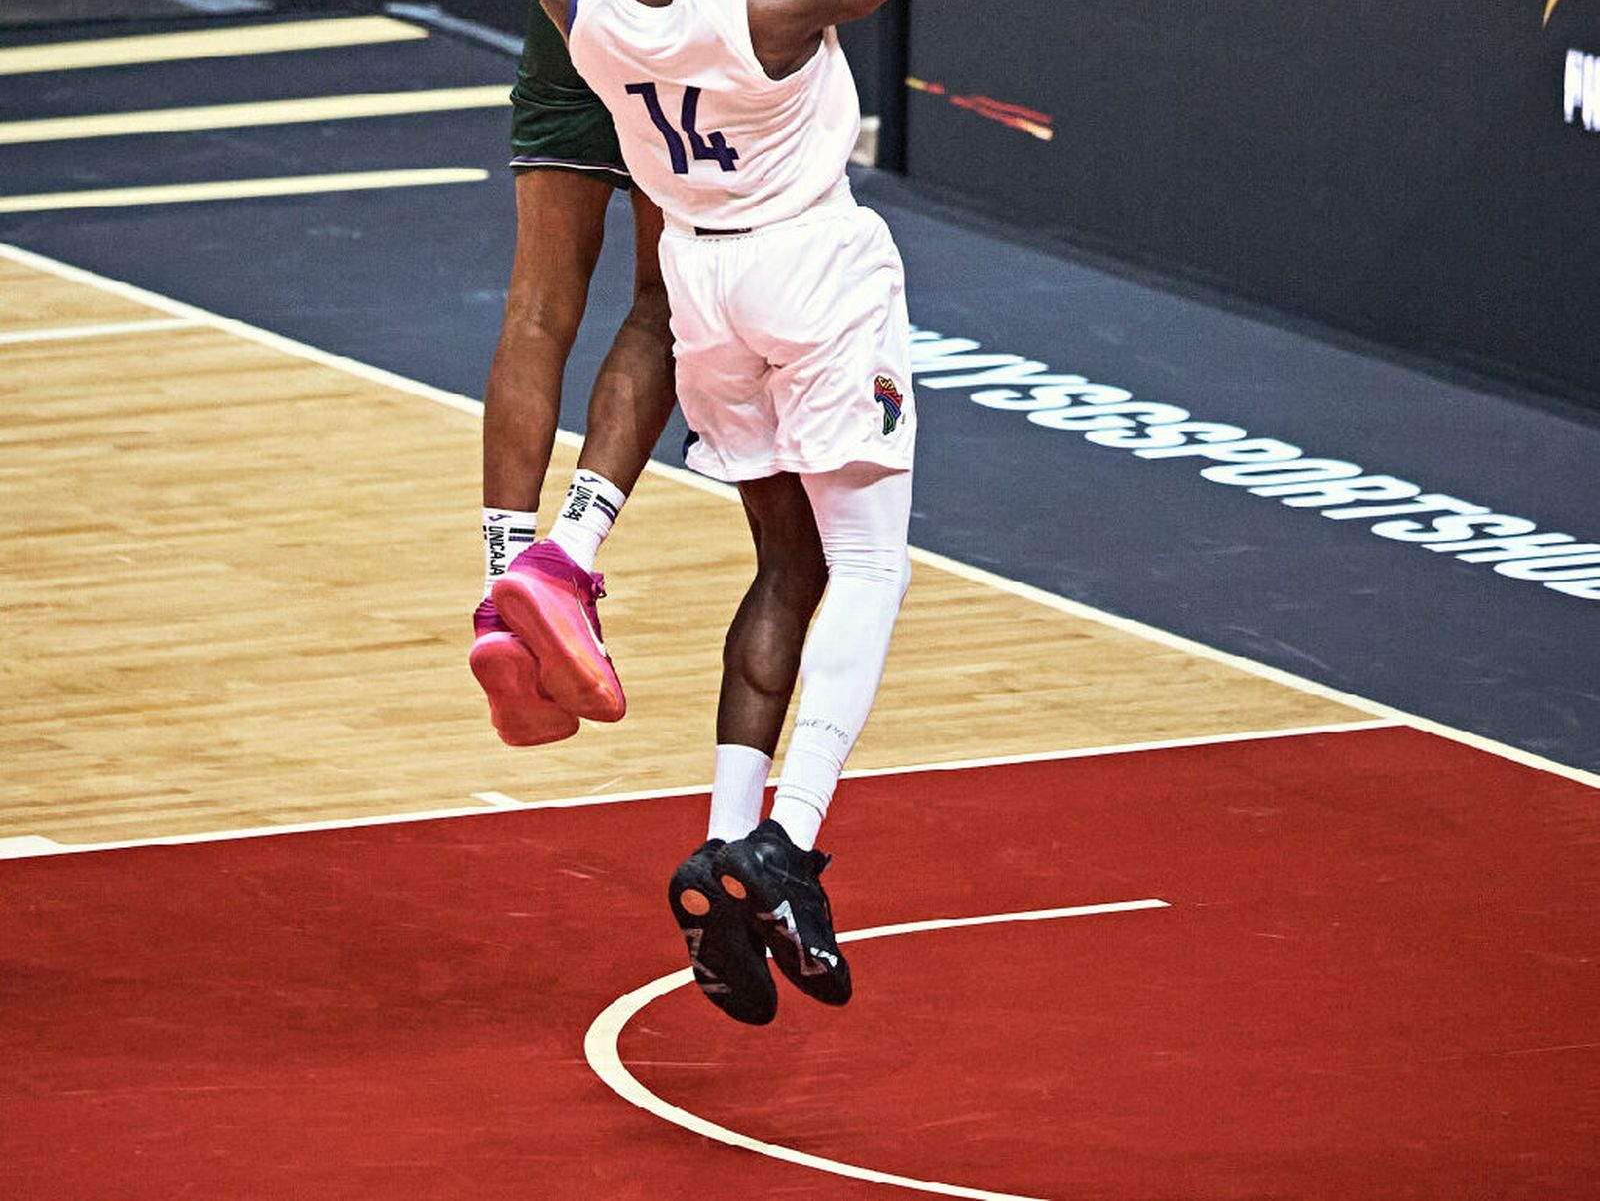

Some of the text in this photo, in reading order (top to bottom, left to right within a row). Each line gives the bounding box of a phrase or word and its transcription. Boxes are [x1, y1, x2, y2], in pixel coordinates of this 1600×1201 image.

[625, 82, 739, 175] 14
[908, 324, 1600, 600] MYSGSPORTSHU
[488, 526, 506, 576] UNICAJA
